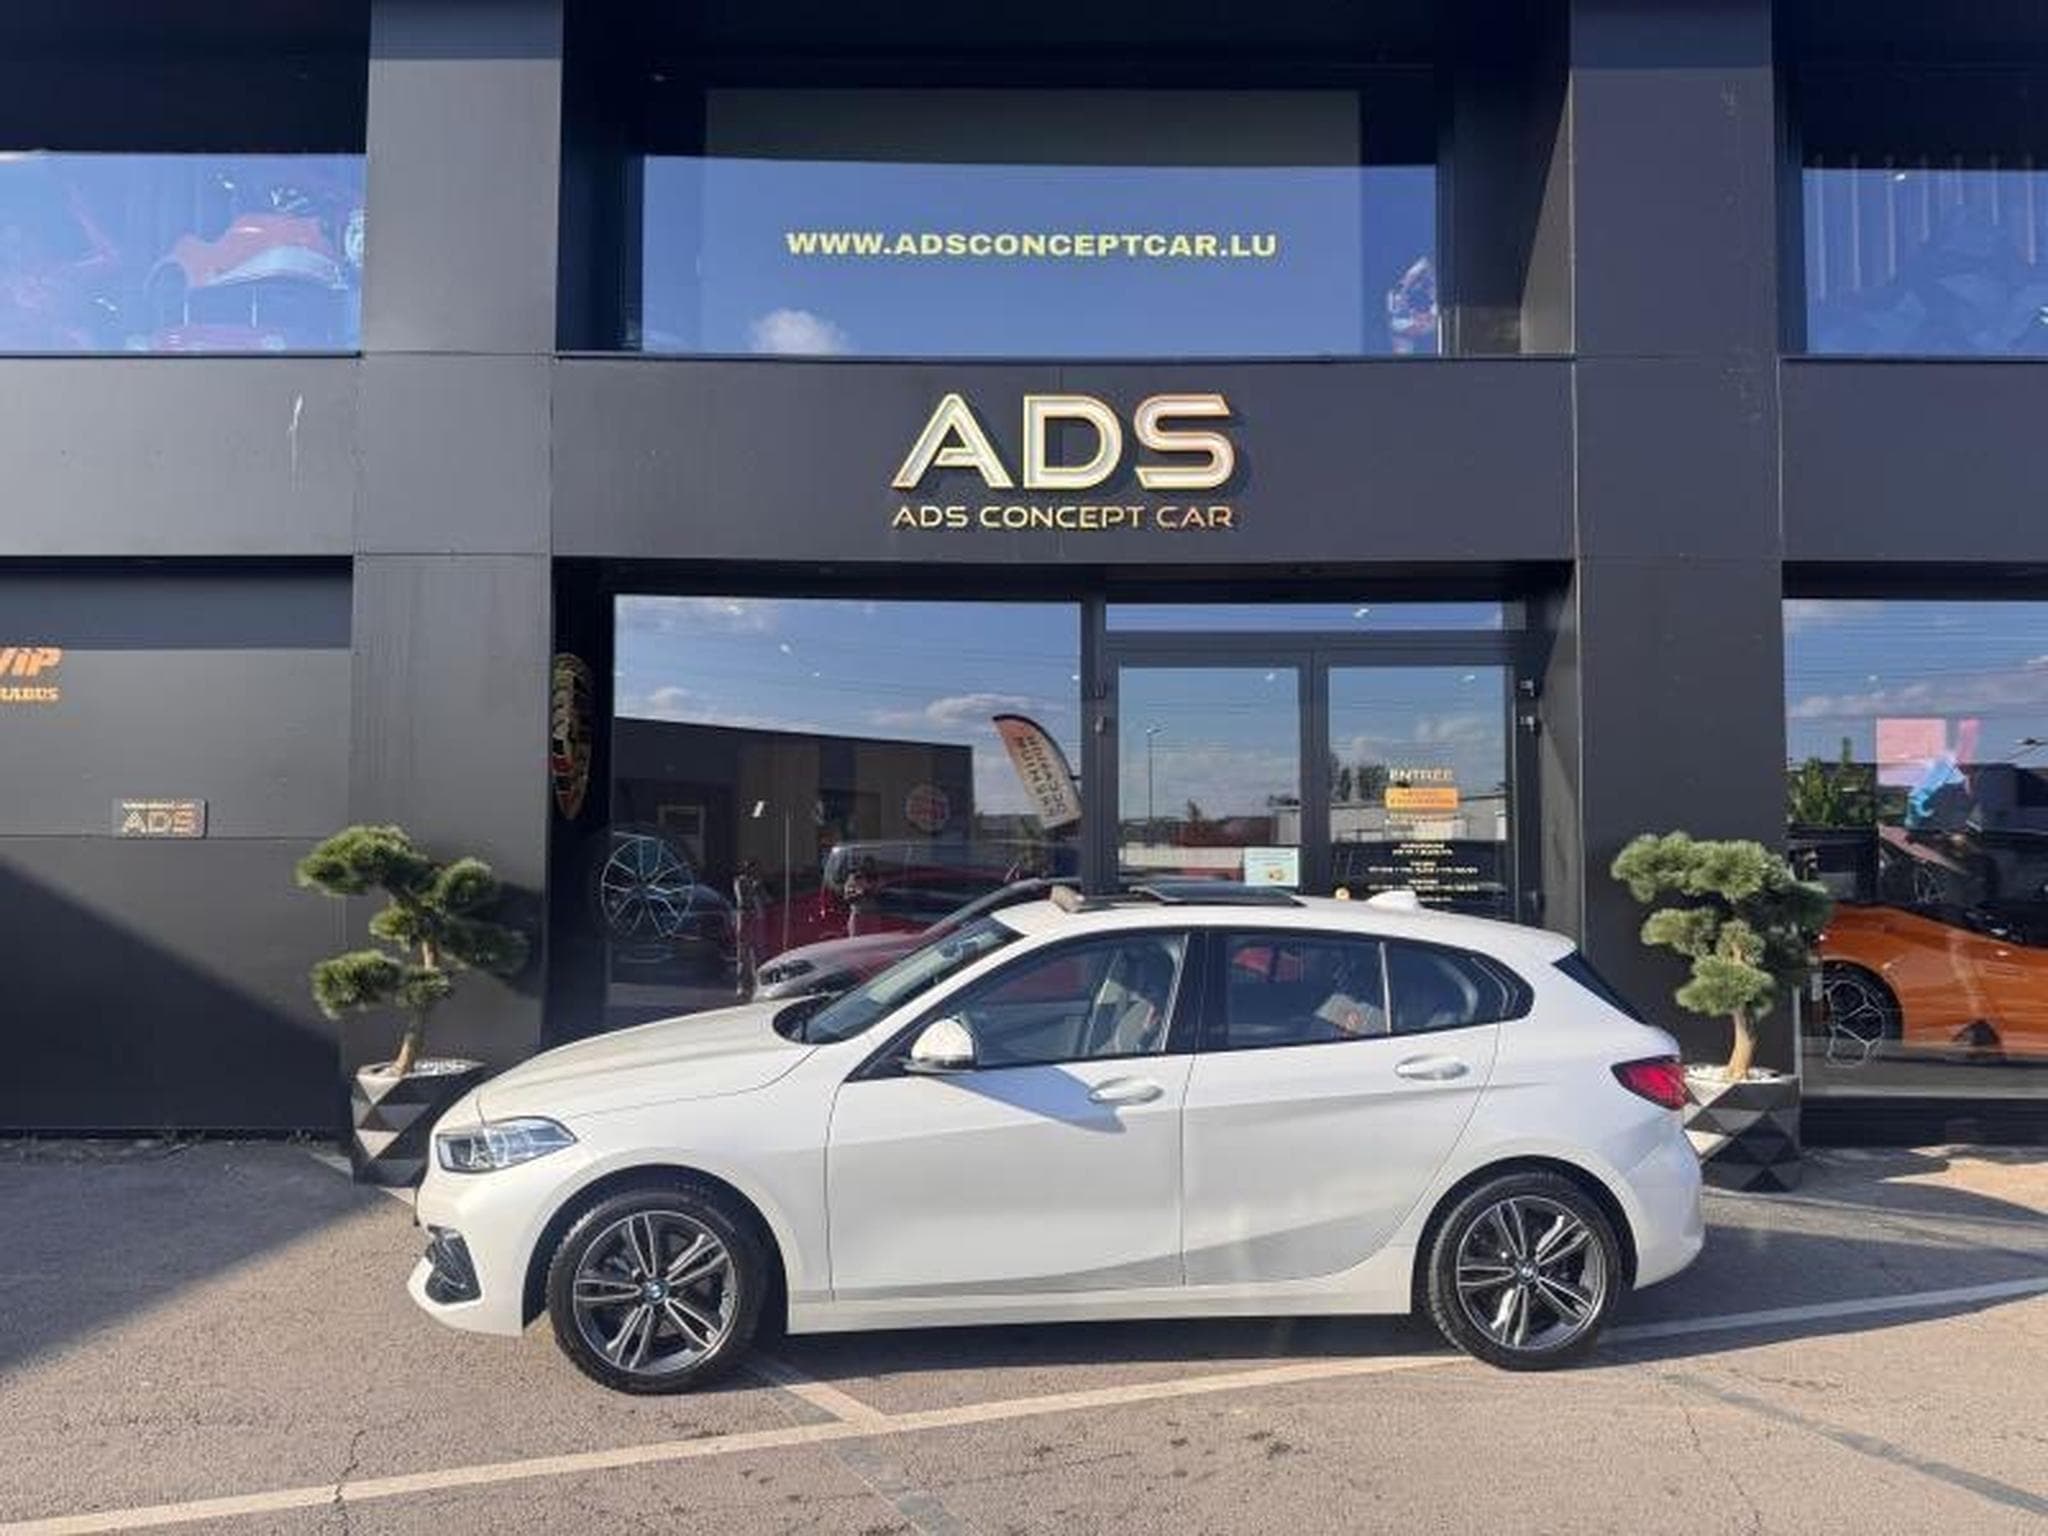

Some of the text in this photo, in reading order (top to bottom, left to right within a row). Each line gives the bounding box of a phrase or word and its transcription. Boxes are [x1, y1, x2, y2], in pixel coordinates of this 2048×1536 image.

[786, 232, 1277, 257] WWW.ADSCONCEPTCAR.LU
[891, 393, 1235, 490] ADS
[892, 506, 1233, 529] ADS CONCEPT CAR
[122, 810, 195, 833] ADS
